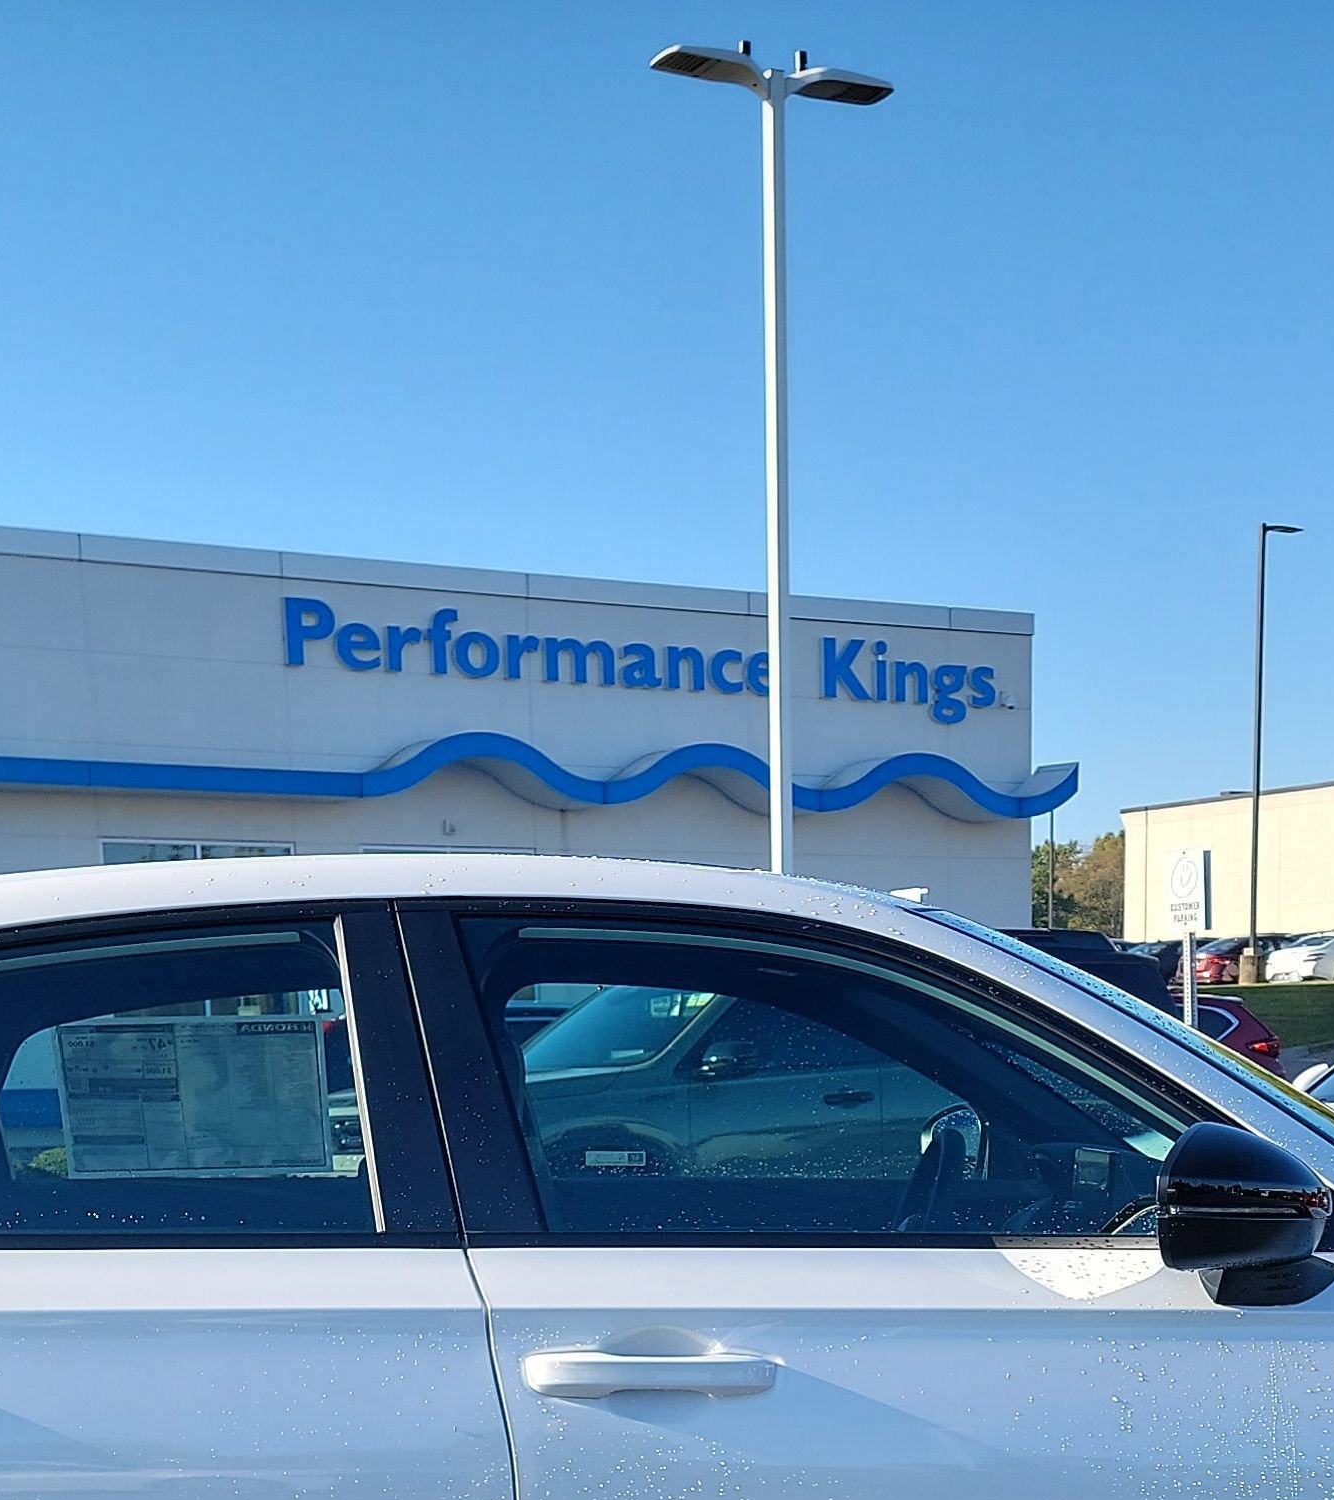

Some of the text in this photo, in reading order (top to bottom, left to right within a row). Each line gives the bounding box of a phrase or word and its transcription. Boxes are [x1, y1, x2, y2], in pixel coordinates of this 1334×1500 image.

[283, 596, 996, 724] Performance Kings
[1170, 902, 1200, 911] CUSTOMER
[1173, 913, 1198, 922] PARKING
